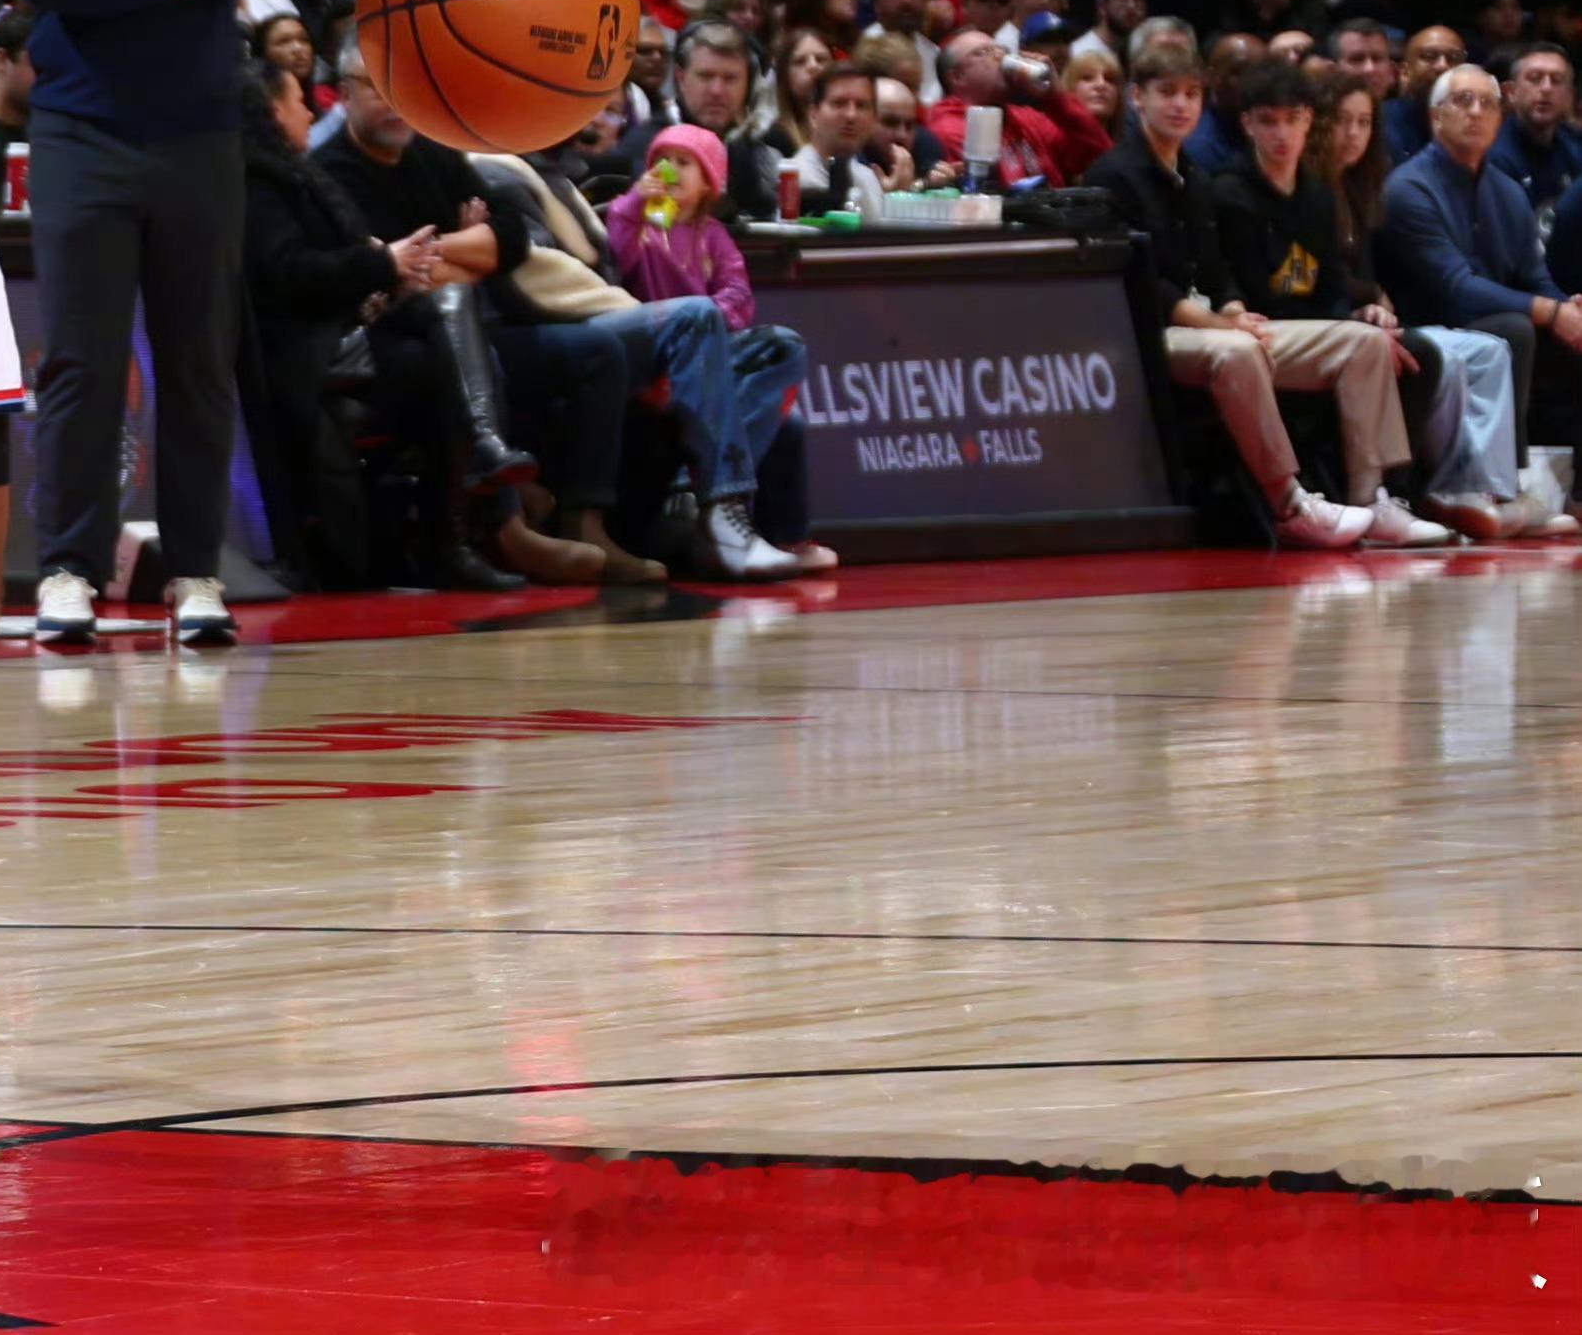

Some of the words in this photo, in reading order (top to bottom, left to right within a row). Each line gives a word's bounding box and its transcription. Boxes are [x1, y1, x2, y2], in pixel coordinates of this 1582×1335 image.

[795, 357, 967, 425] LLSVIEW
[972, 351, 1117, 417] CASINO
[856, 431, 964, 473] NIAGARA
[977, 426, 1043, 464] FALLS
